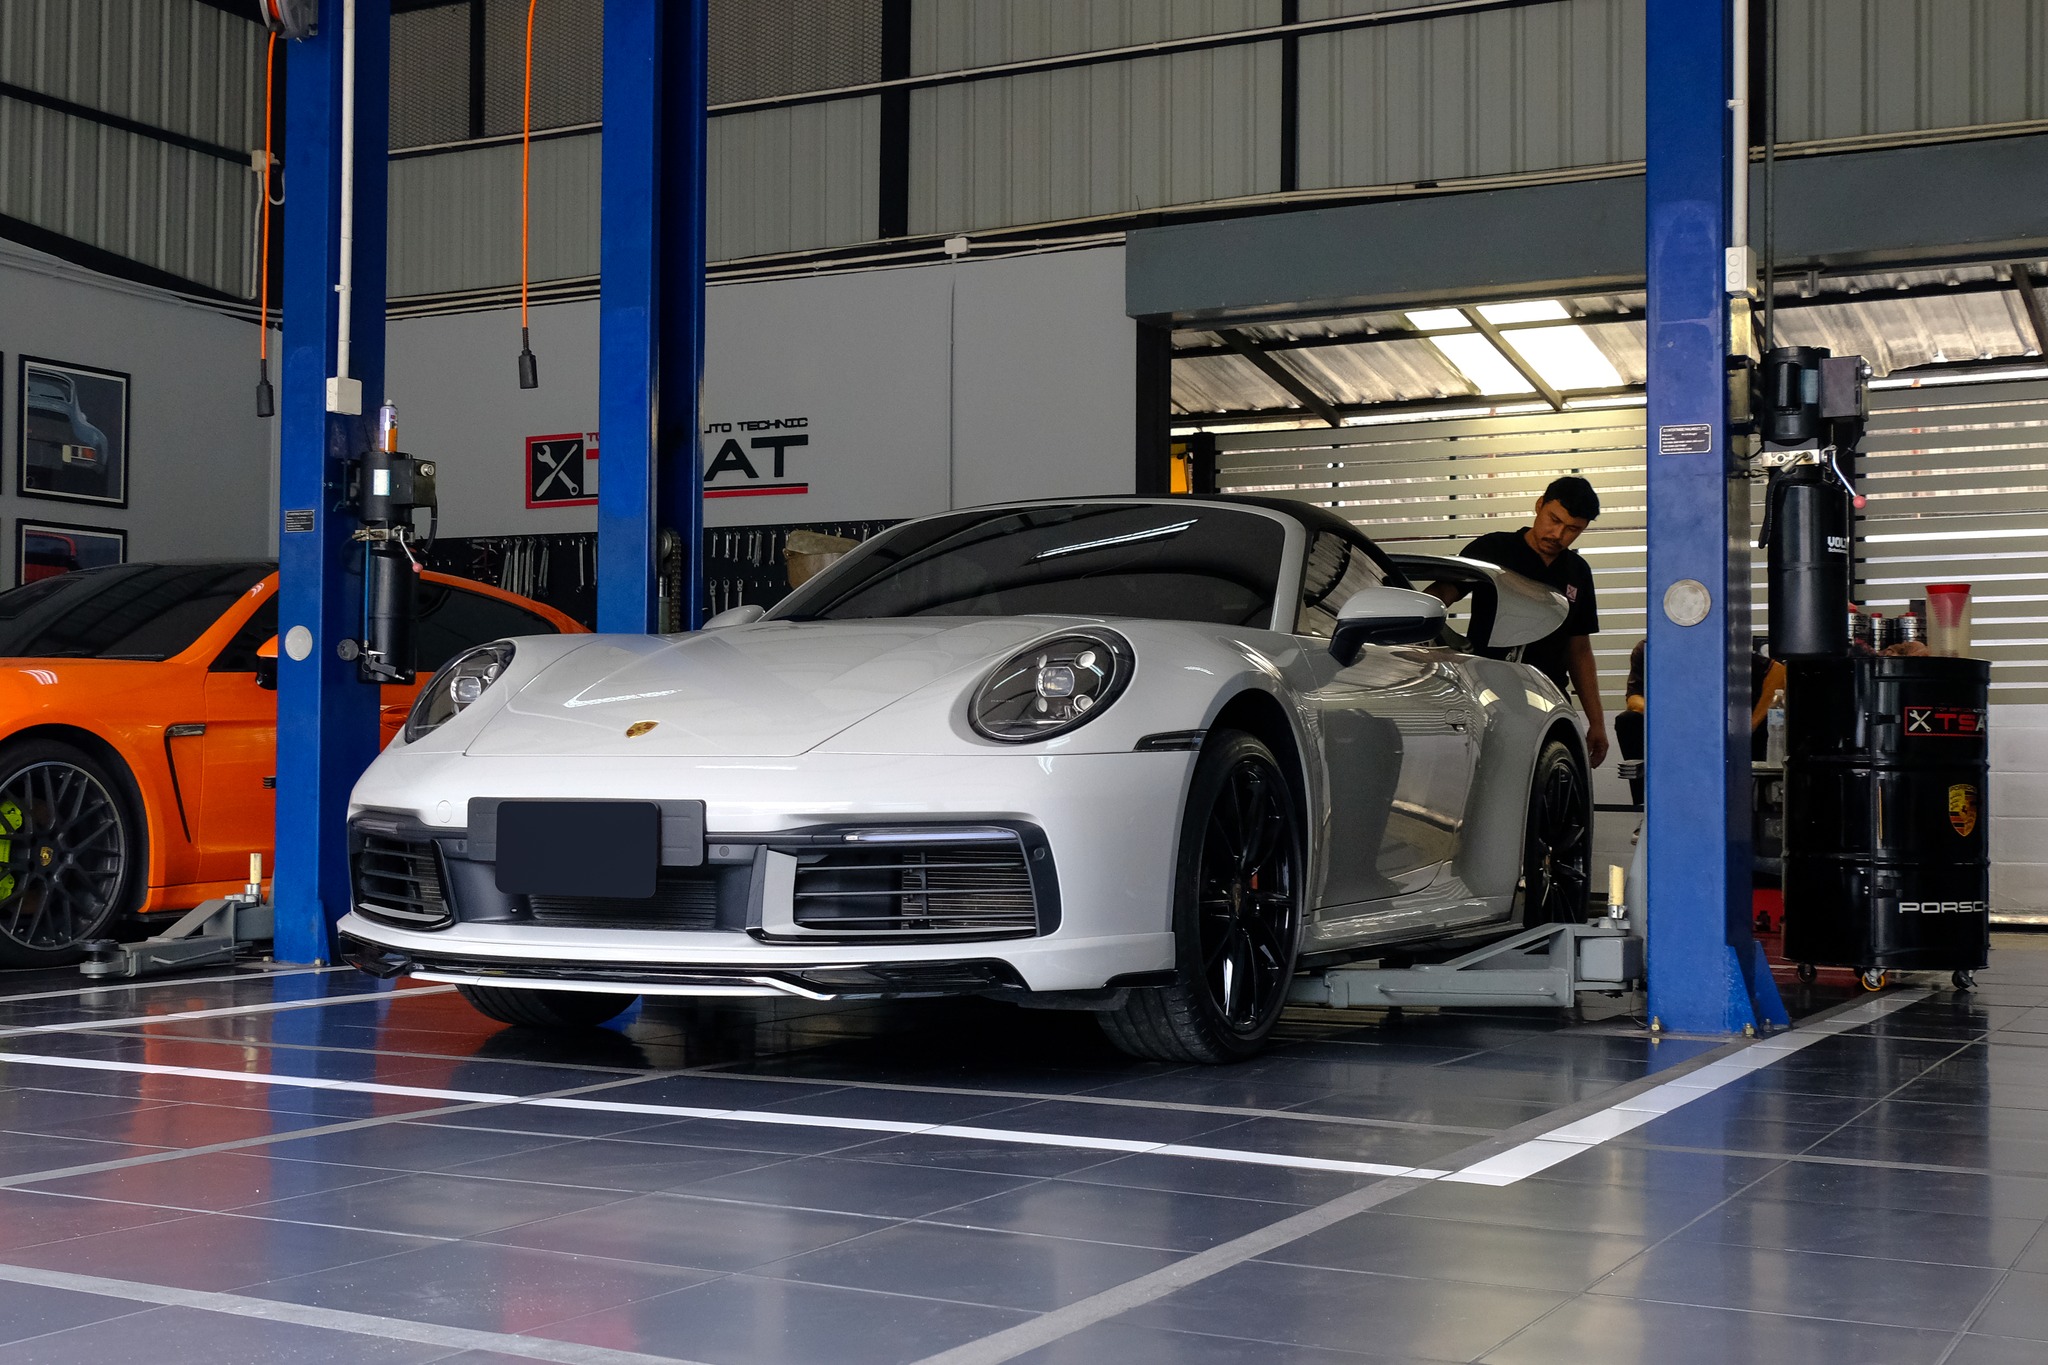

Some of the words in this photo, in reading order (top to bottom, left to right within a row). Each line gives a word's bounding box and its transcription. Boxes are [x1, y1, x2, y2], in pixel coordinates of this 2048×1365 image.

[703, 423, 732, 433] UTO
[737, 417, 808, 431] TECHNIC
[703, 434, 809, 482] AT
[1935, 713, 1987, 732] TSA
